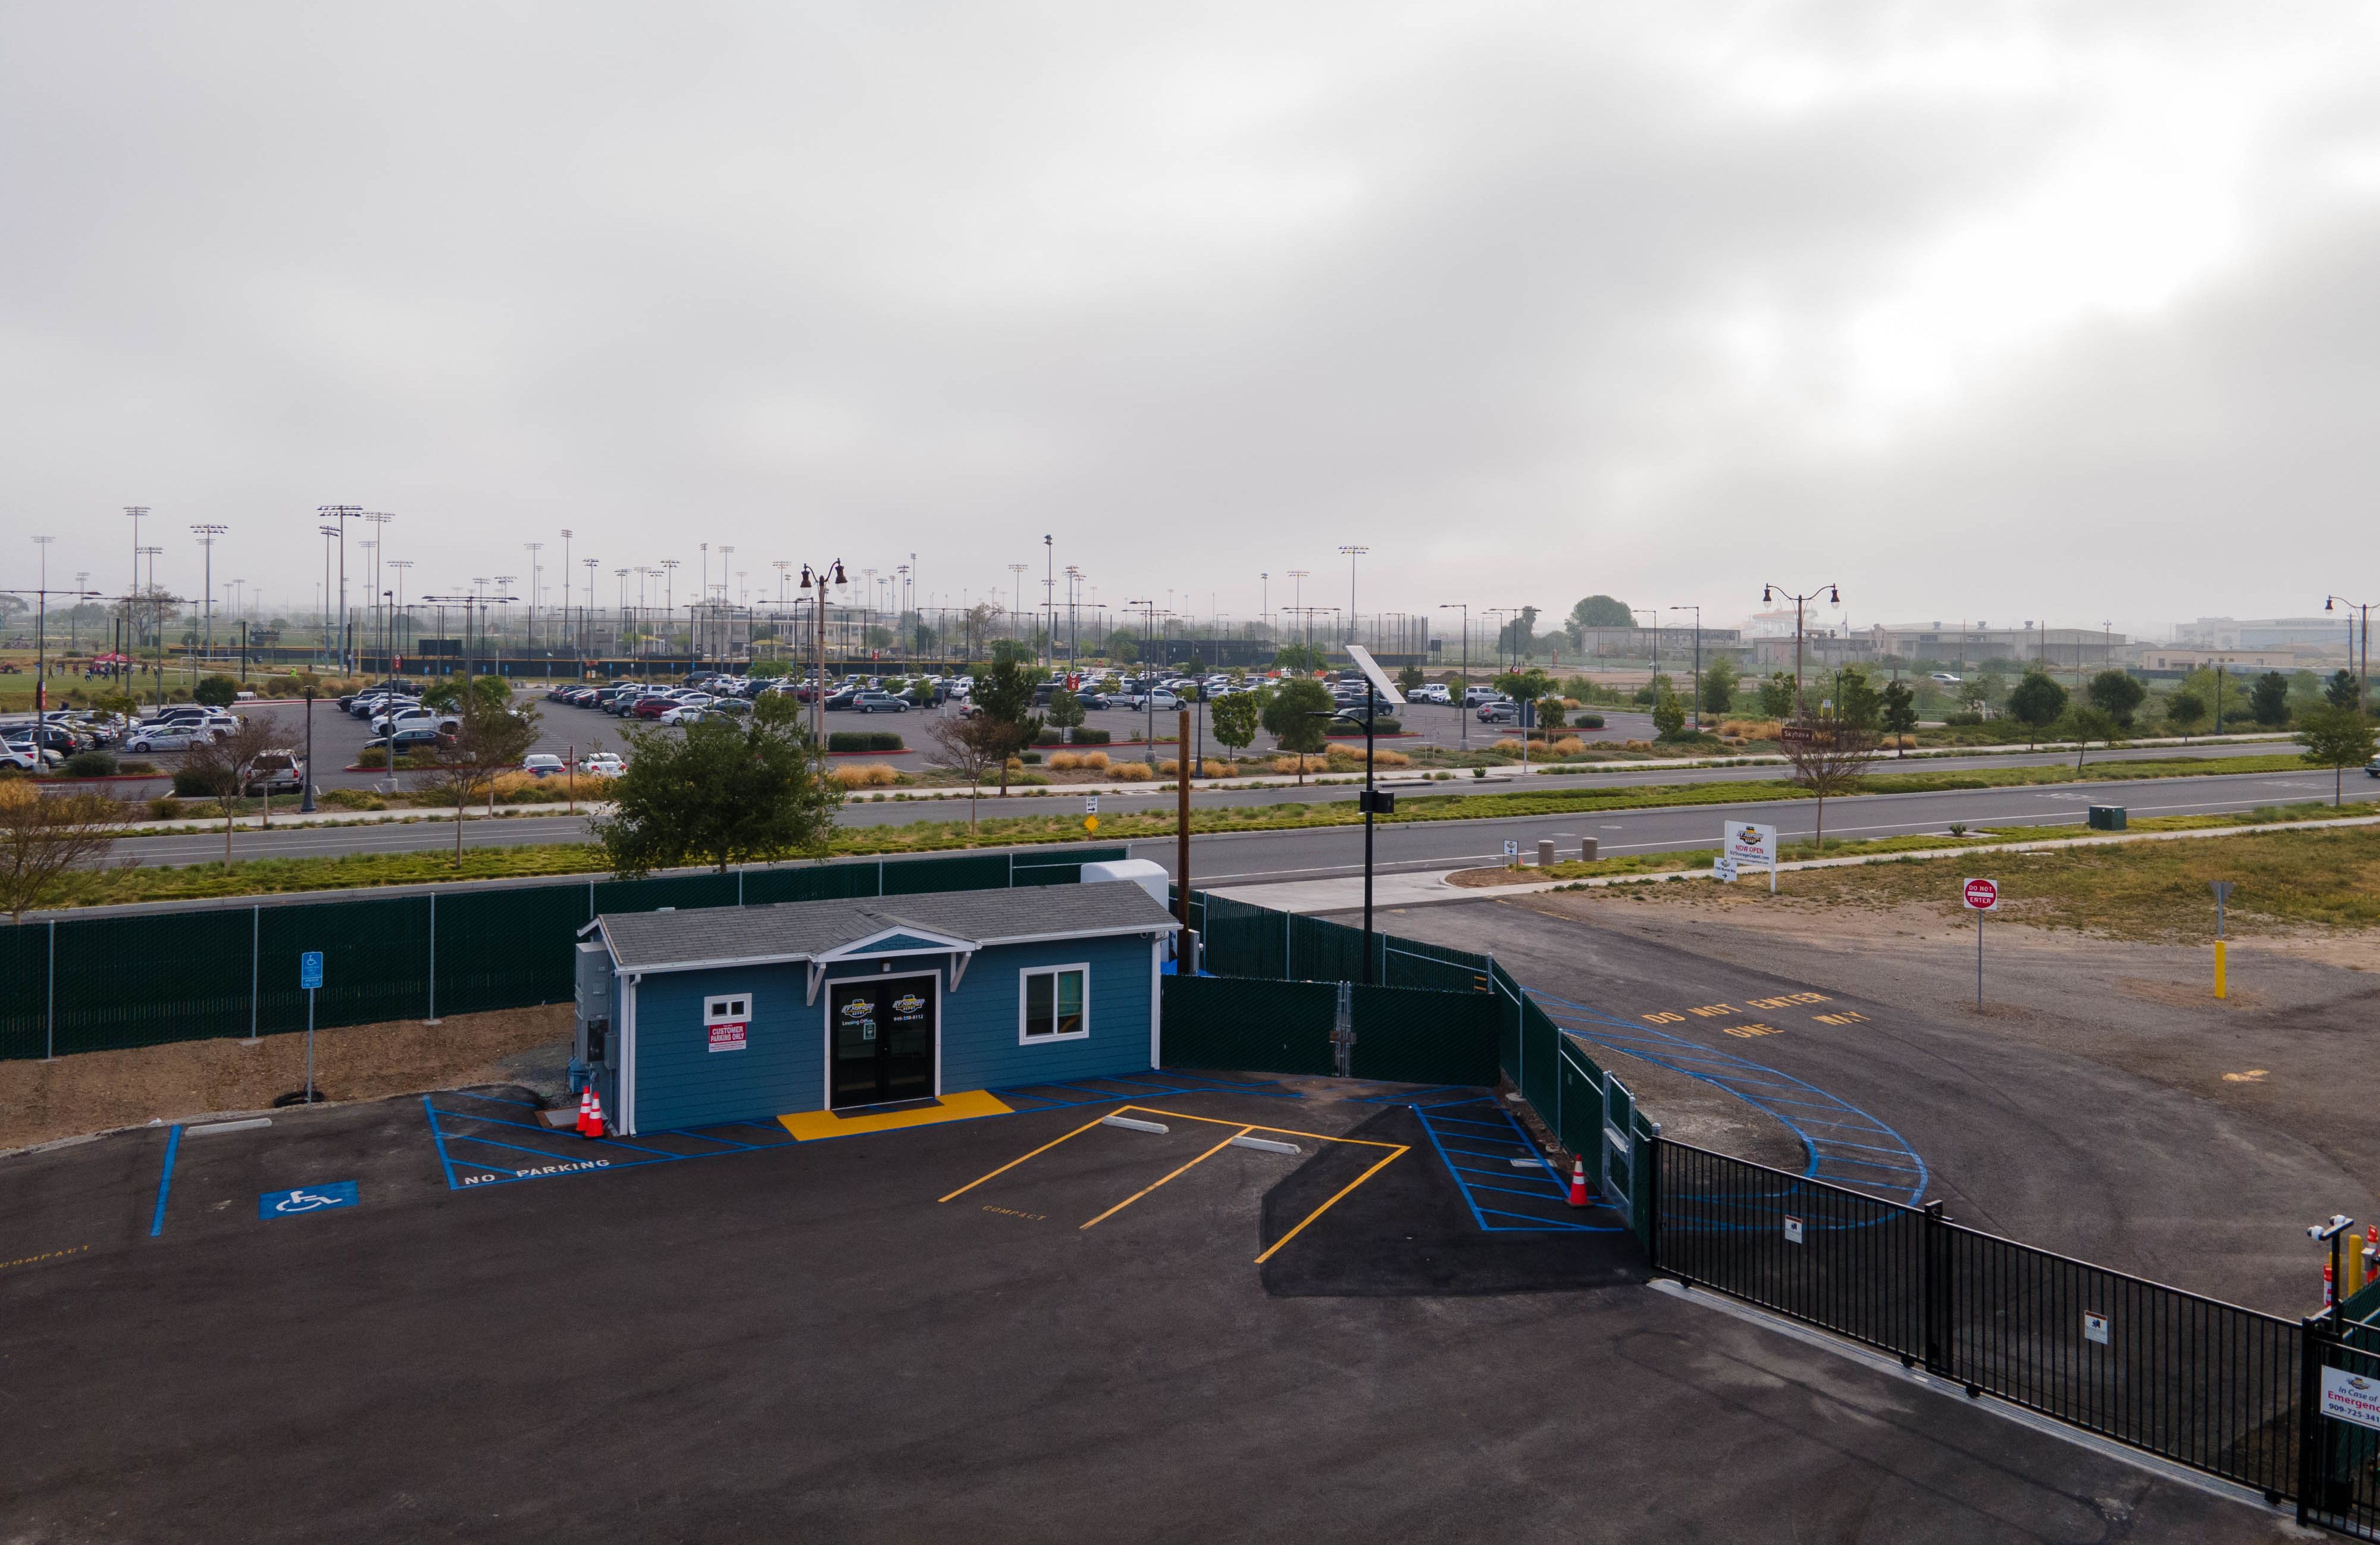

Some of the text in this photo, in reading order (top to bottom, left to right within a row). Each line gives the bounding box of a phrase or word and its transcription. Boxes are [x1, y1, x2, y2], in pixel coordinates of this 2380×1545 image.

[1642, 992, 1833, 1024] DO NOT ENTER
[712, 1026, 743, 1035] CUSTOMER
[1723, 1011, 1871, 1038] ONE WAY
[710, 1034, 731, 1042] PARKING
[464, 1159, 610, 1184] NO PARKING
[982, 1206, 1046, 1221] COMPACT
[0, 1245, 89, 1268] COMPACT
[2348, 1389, 2367, 1399] Case
